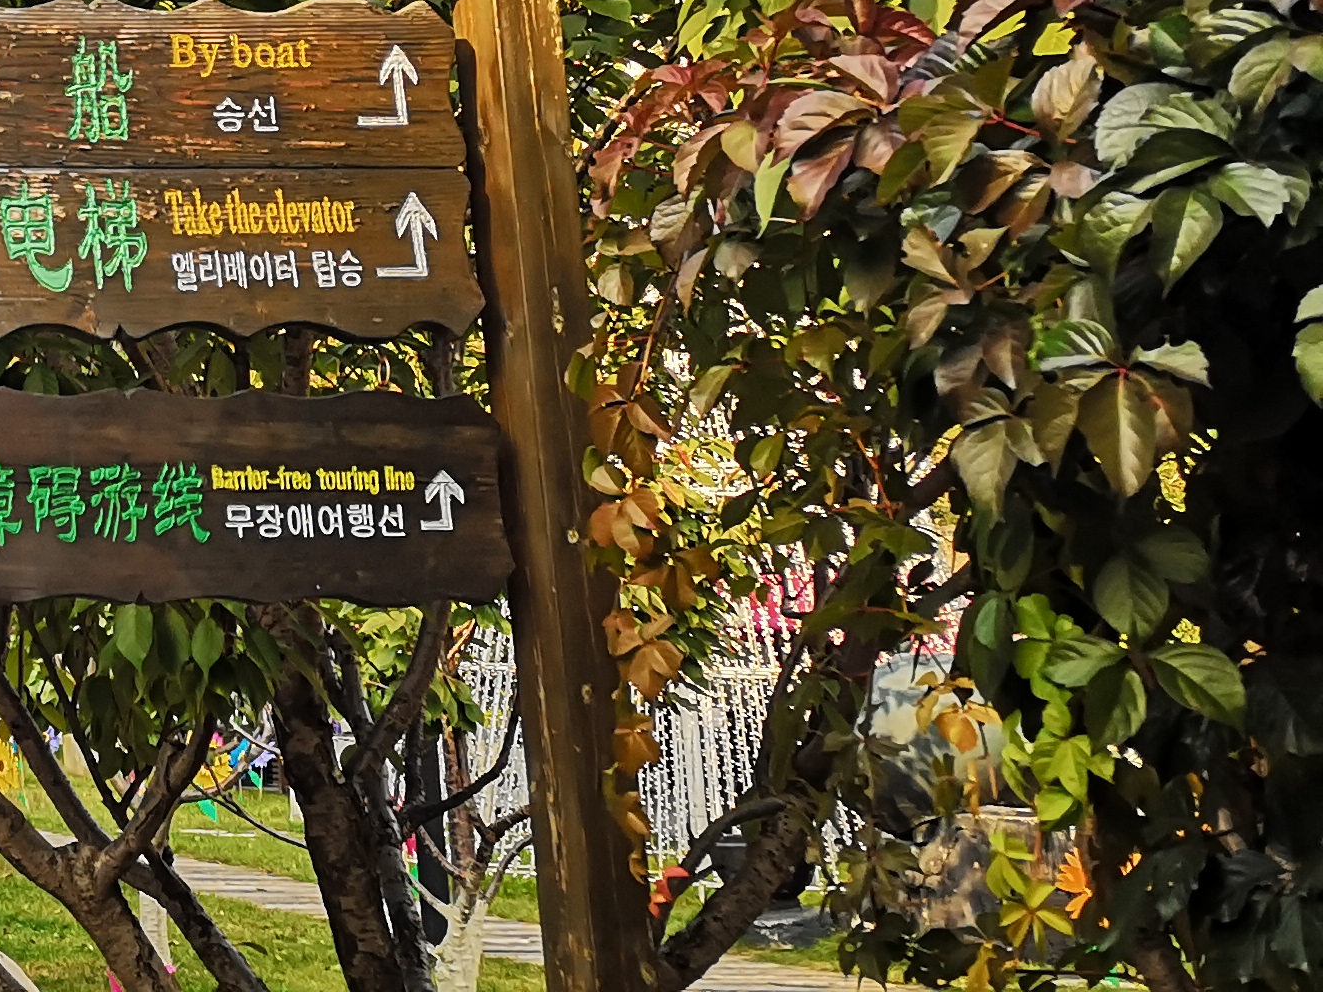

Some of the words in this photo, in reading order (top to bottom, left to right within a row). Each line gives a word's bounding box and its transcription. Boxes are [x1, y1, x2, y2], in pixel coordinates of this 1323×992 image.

[169, 33, 220, 78] By
[229, 33, 312, 69] boat
[212, 95, 280, 133] 승선
[164, 188, 224, 236] Take
[225, 187, 264, 235] the
[265, 187, 355, 235] elevator
[170, 248, 300, 293] 엘리베이터
[310, 248, 363, 289] 탑승
[210, 464, 312, 492] Barrier-free
[315, 465, 381, 496] touring
[383, 465, 416, 492] line
[224, 503, 407, 540] 무장애여행선
